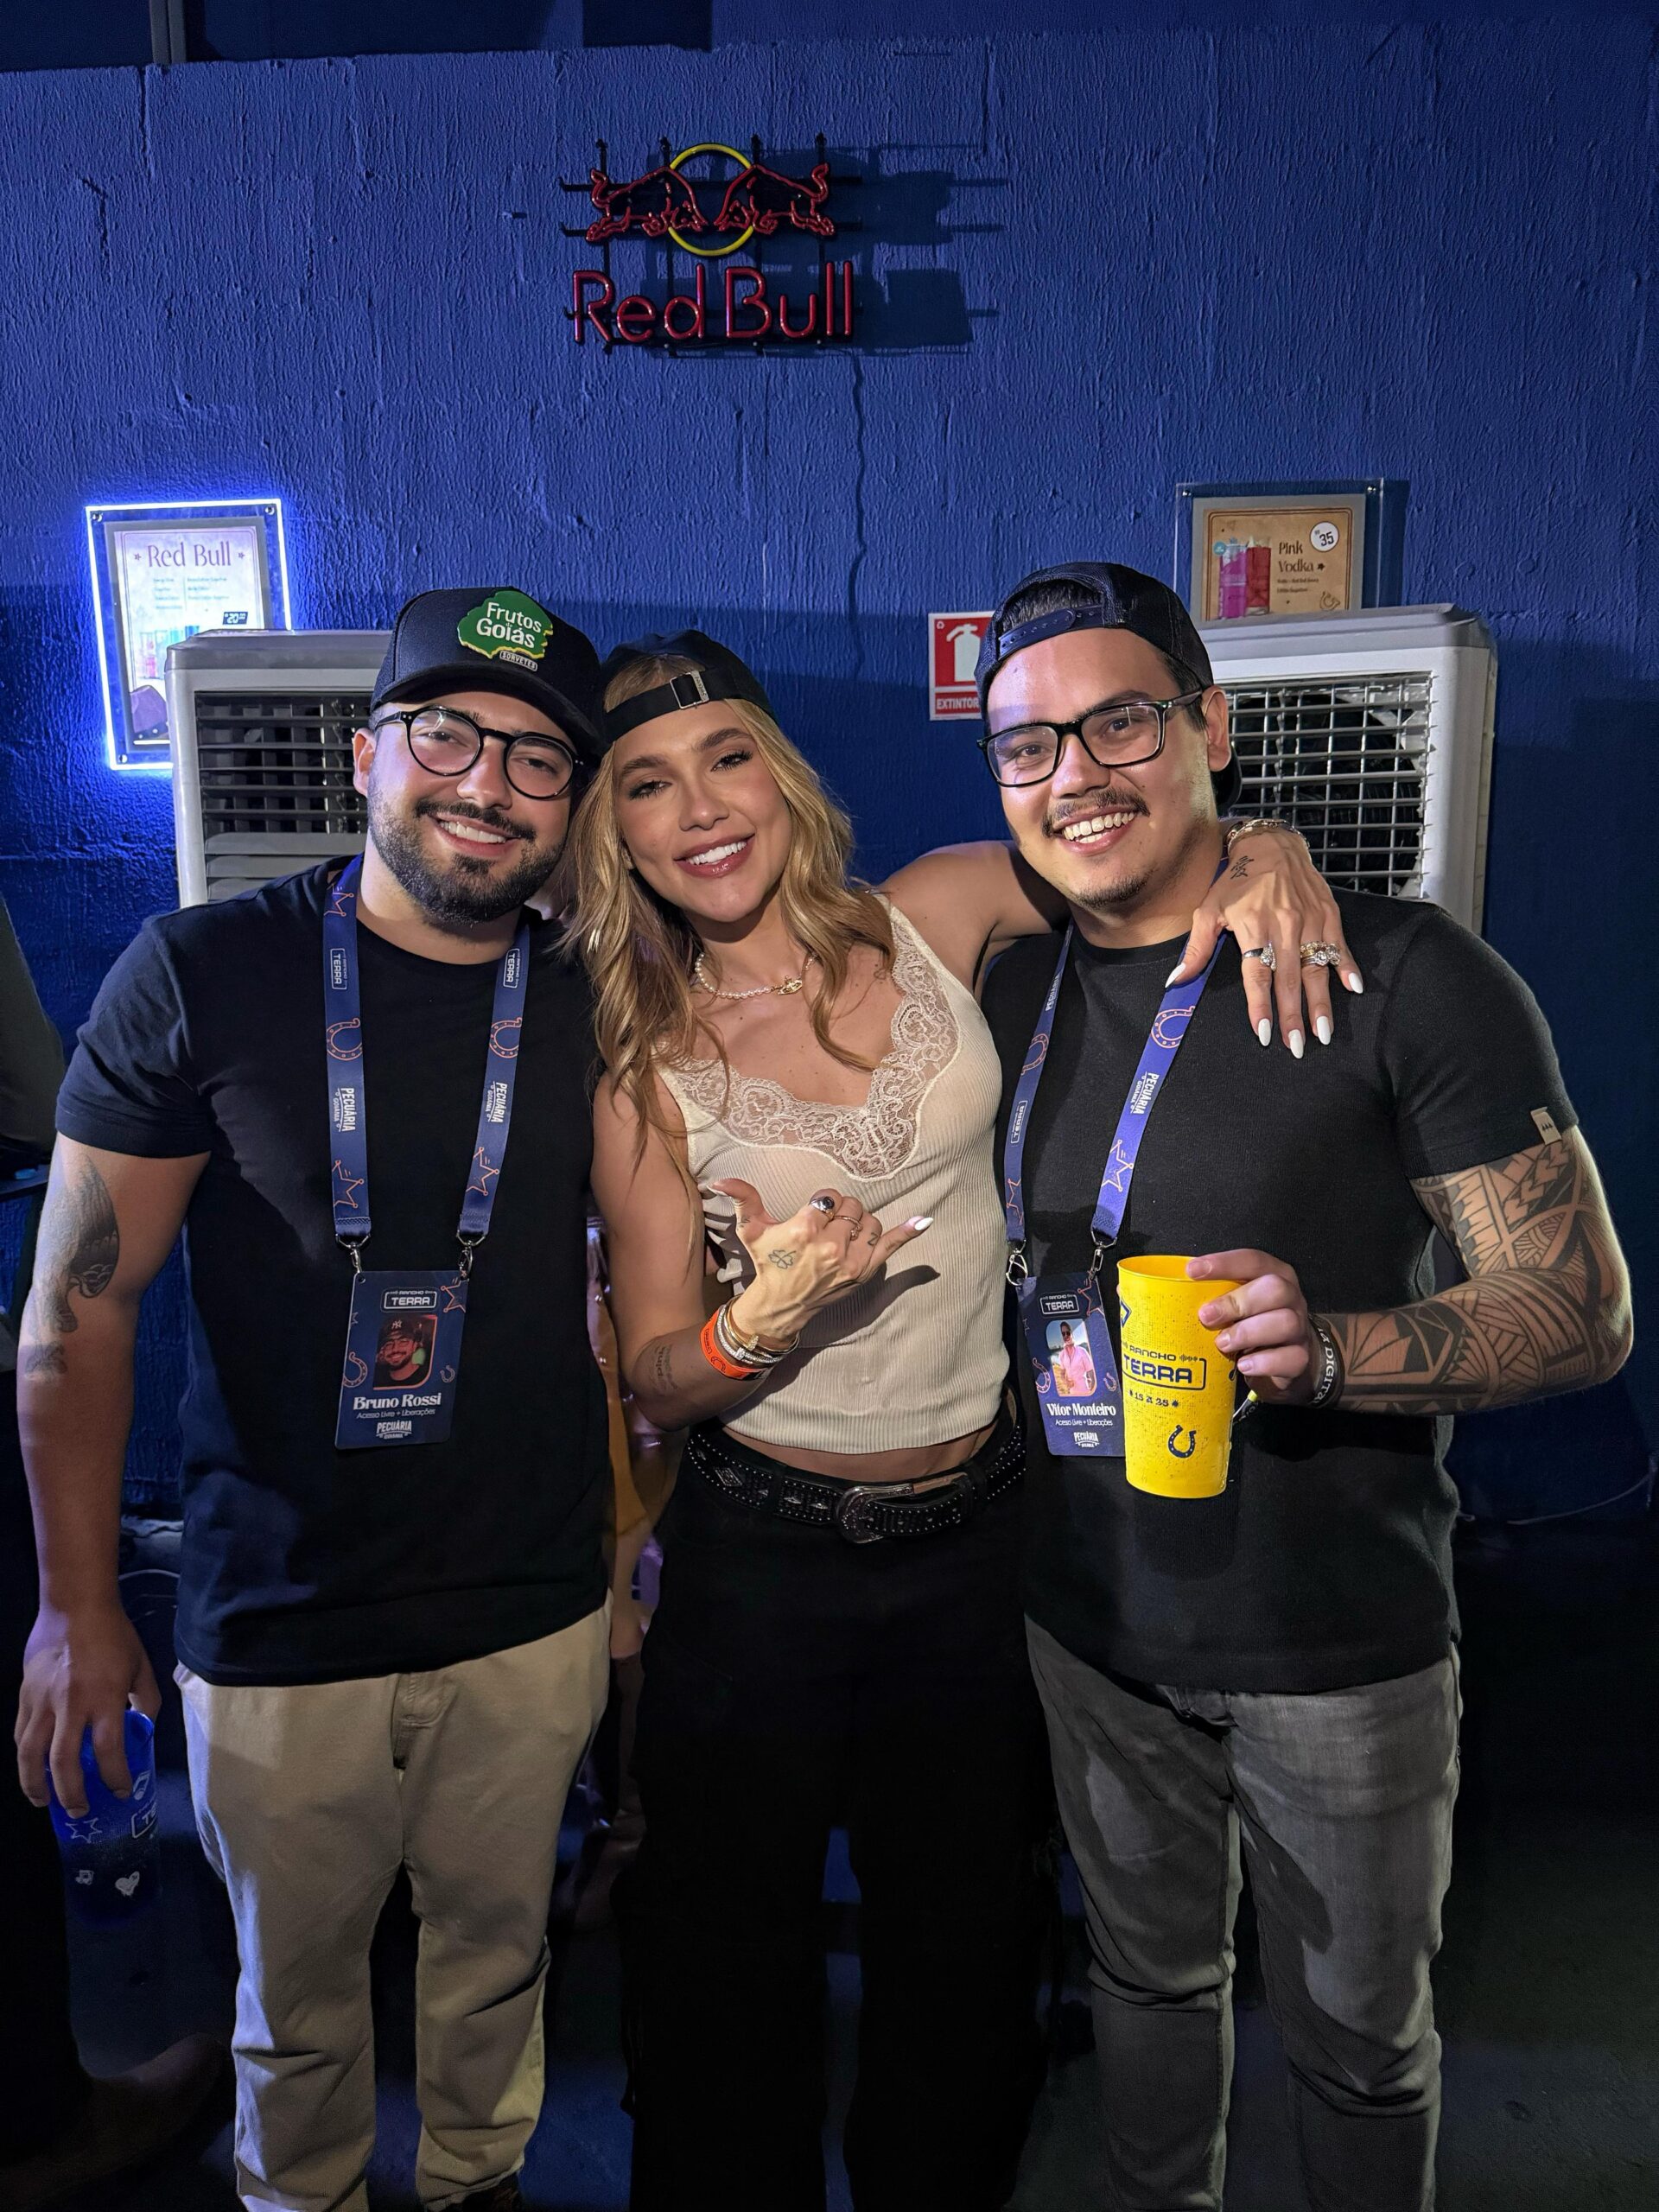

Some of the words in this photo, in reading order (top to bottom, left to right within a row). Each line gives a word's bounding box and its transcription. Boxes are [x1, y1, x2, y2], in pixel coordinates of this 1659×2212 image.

[573, 264, 705, 344] Red
[725, 261, 853, 340] Bull
[1278, 540, 1303, 555] Pink
[1319, 531, 1334, 546] 35
[147, 542, 186, 568] Red
[194, 540, 232, 567] Bull
[1278, 559, 1314, 573] Vodka
[486, 601, 542, 633] Frutos
[476, 617, 535, 649] Goiás
[501, 651, 537, 670] SORVETES
[334, 953, 342, 984] TERRA
[506, 952, 516, 983] TERRA
[340, 1087, 357, 1132] PECUÁRIA
[1014, 1105, 1025, 1138] TERRA
[391, 1296, 430, 1306] TERRA
[1045, 1300, 1075, 1311] TERRA
[1129, 1344, 1176, 1362] RANCHO
[1123, 1353, 1192, 1384] TERRA
[353, 1396, 399, 1410] Bruno
[401, 1392, 442, 1408] Rossi
[1046, 1402, 1071, 1416] Vitor
[1071, 1402, 1117, 1416] Monteiro
[376, 1420, 412, 1433] PECUÁRIA
